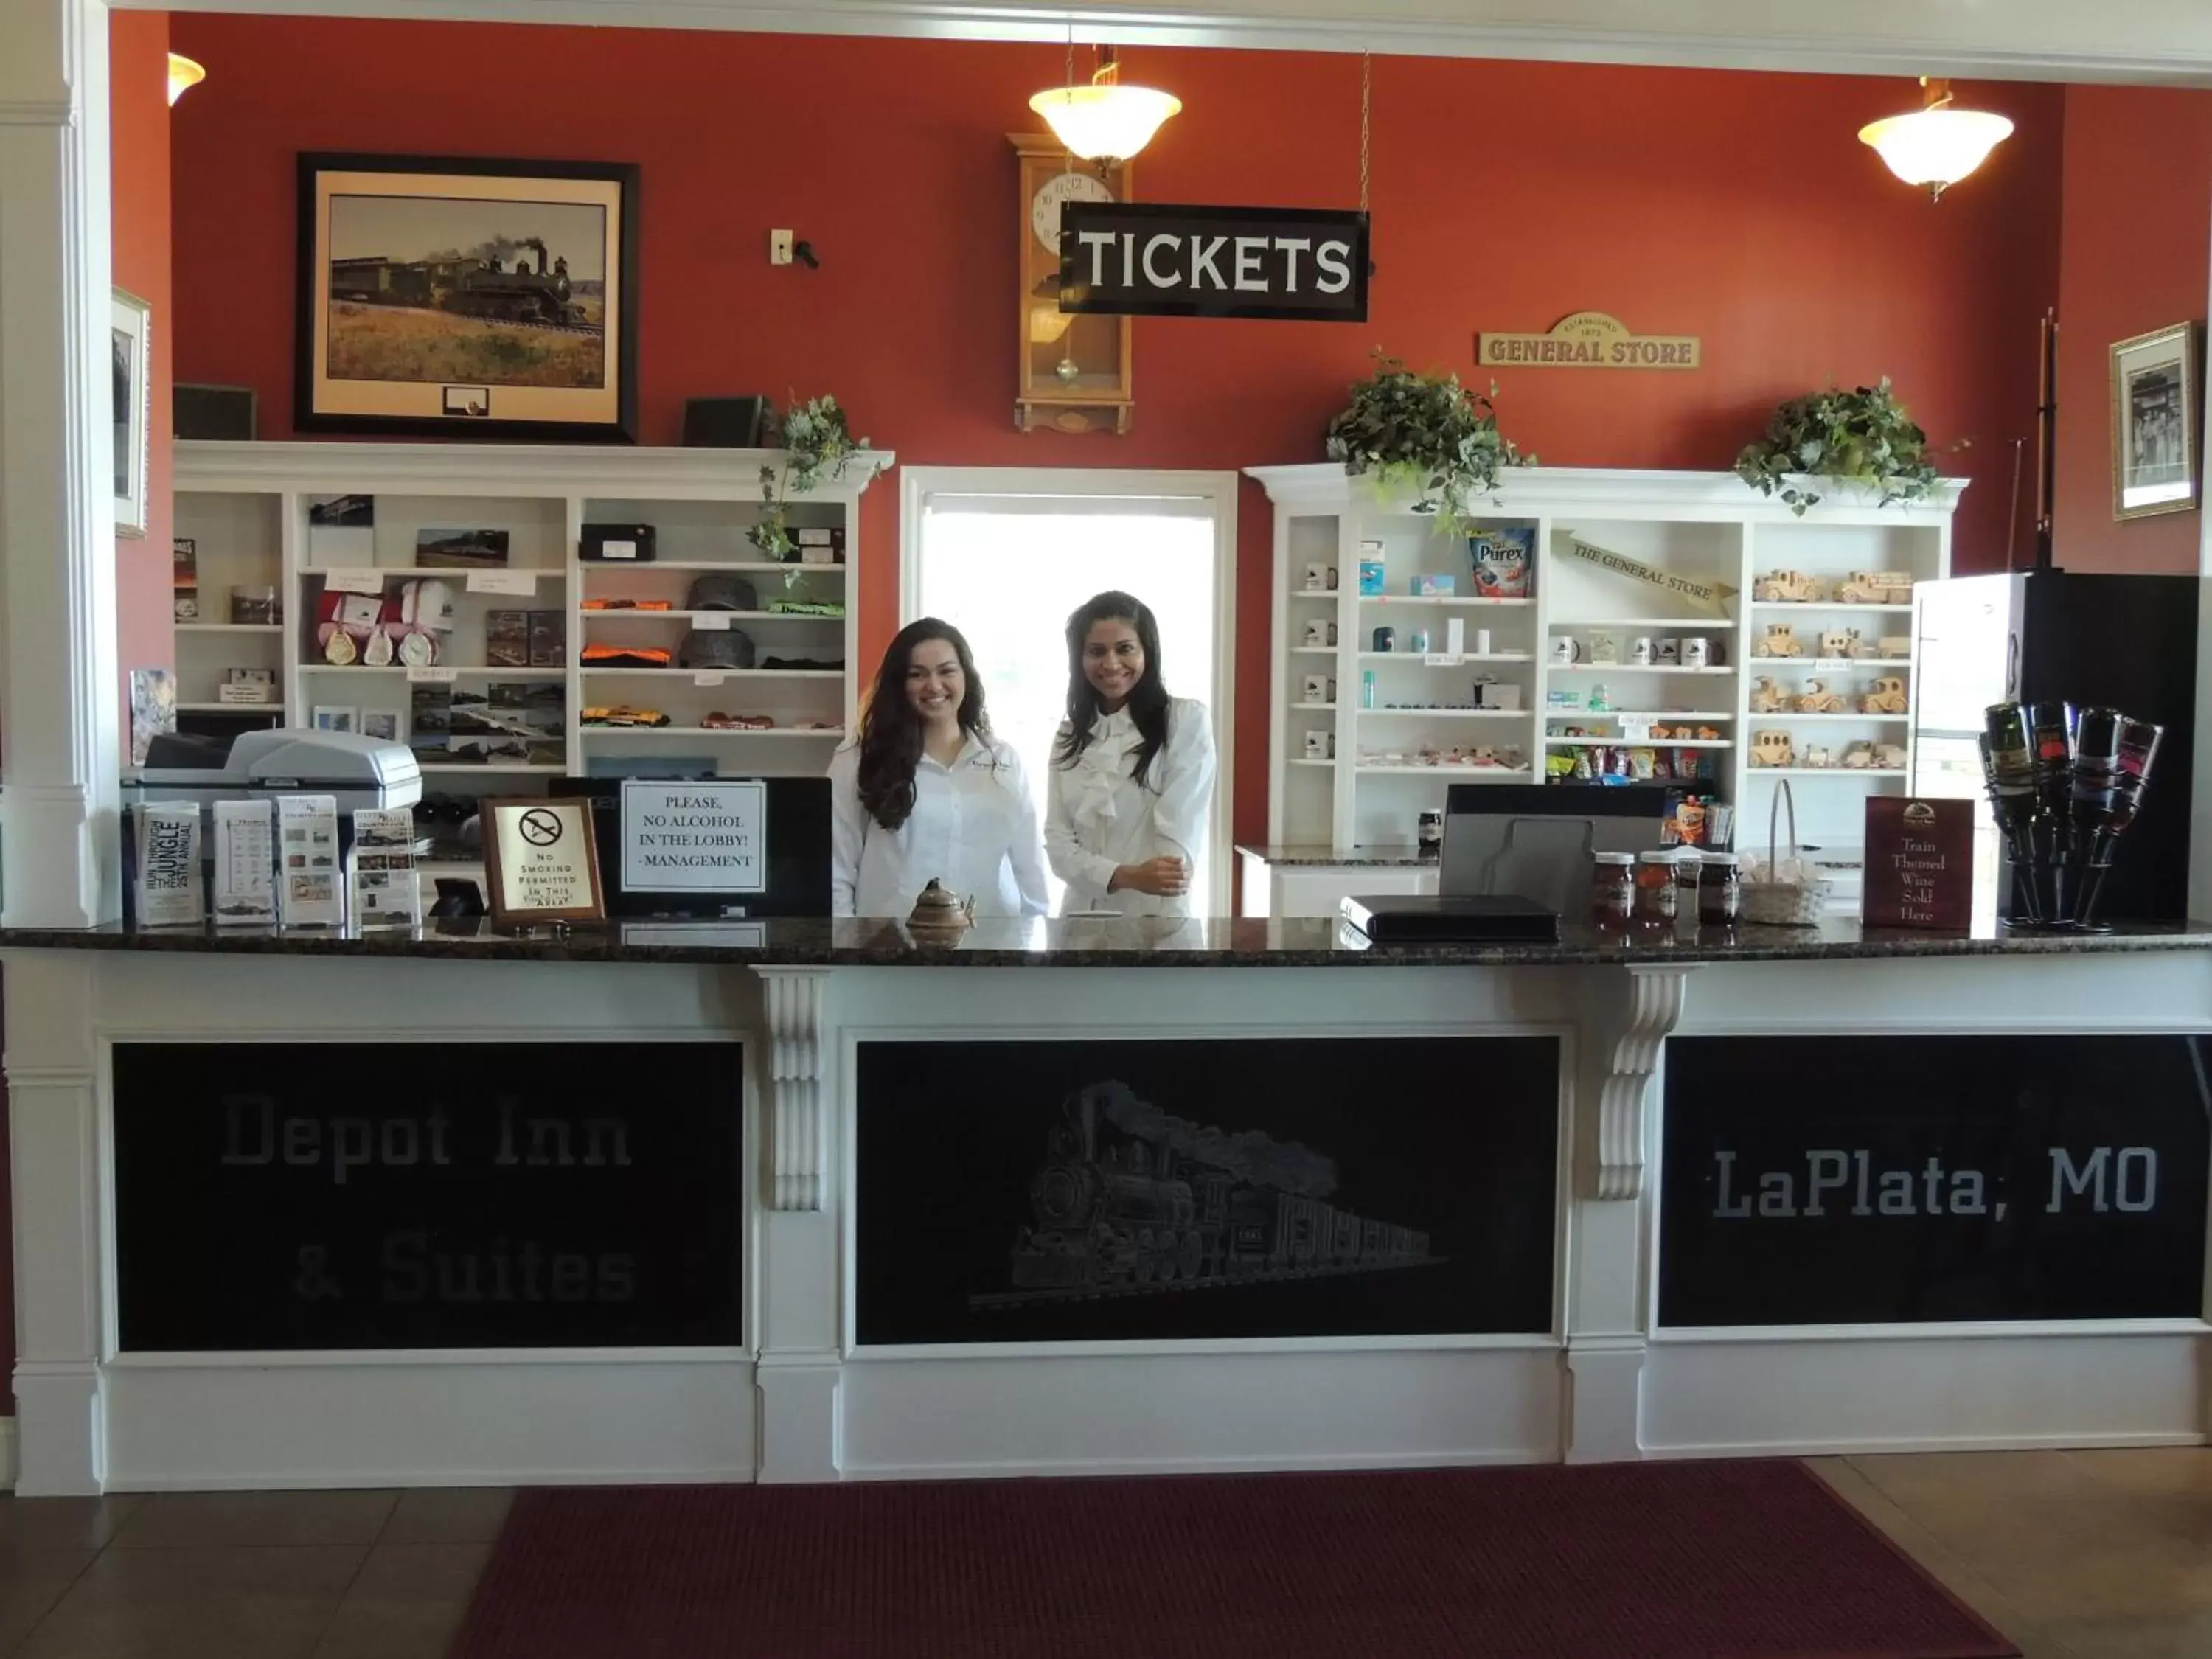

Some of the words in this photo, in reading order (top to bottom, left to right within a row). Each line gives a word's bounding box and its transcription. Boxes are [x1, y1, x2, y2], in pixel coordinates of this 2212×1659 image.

[1071, 176, 1082, 189] 12
[1079, 230, 1352, 294] TICKETS
[1488, 339, 1604, 364] GENERAL
[1612, 342, 1691, 364] STORE
[1480, 545, 1523, 560] Purex
[1573, 543, 1601, 563] THE
[1602, 554, 1664, 585] GENERAL
[1667, 577, 1713, 600] STORE
[644, 815, 666, 827] NO
[670, 815, 744, 827] ALCOHOL
[178, 822, 192, 860] ANNUAL
[639, 834, 655, 846] IN
[659, 834, 691, 846] THE
[695, 834, 748, 847] LOBBY!
[1902, 838, 1935, 852] Train
[157, 821, 180, 877] JUNGLE
[1892, 854, 1945, 870] Themed
[1901, 872, 1935, 887] Wine
[1901, 889, 1933, 904] Sold
[1900, 907, 1933, 921] Here
[221, 1093, 451, 1184] Depot
[494, 1094, 633, 1166] Inn
[1712, 1150, 2008, 1222] LaPlata,
[2046, 1147, 2157, 1212] MO
[295, 1244, 342, 1302] &
[381, 1230, 637, 1303] Suites
